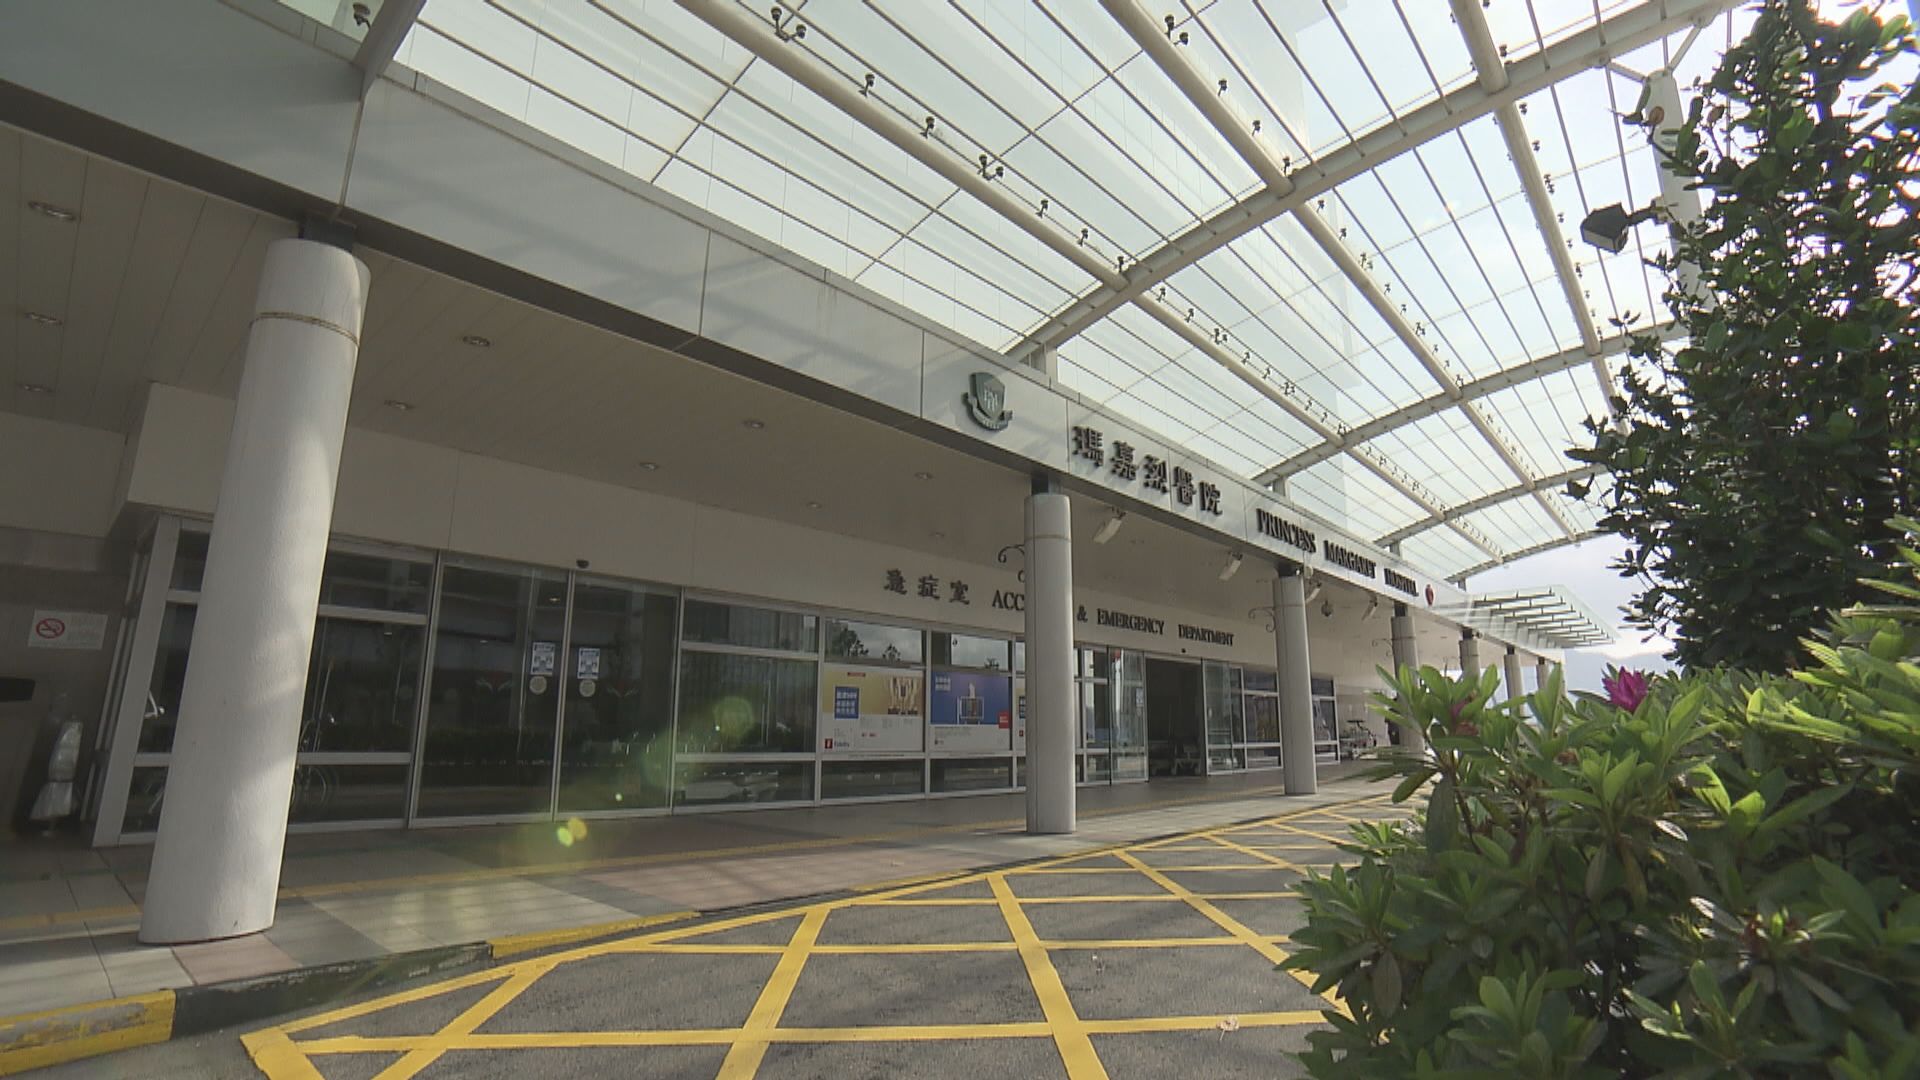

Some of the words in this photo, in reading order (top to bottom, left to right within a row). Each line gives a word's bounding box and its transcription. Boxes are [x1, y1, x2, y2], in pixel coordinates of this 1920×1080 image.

[1072, 426, 1222, 515] 瑪嘉烈醫院
[1256, 508, 1317, 553] PRINCESS
[1323, 540, 1377, 579] MARGARET
[1384, 568, 1419, 597] HOSPITAL
[884, 568, 970, 605] 急症室
[1077, 605, 1088, 622] &
[1097, 608, 1165, 635] EMERGENCY
[1178, 624, 1234, 646] DEPARTMENT
